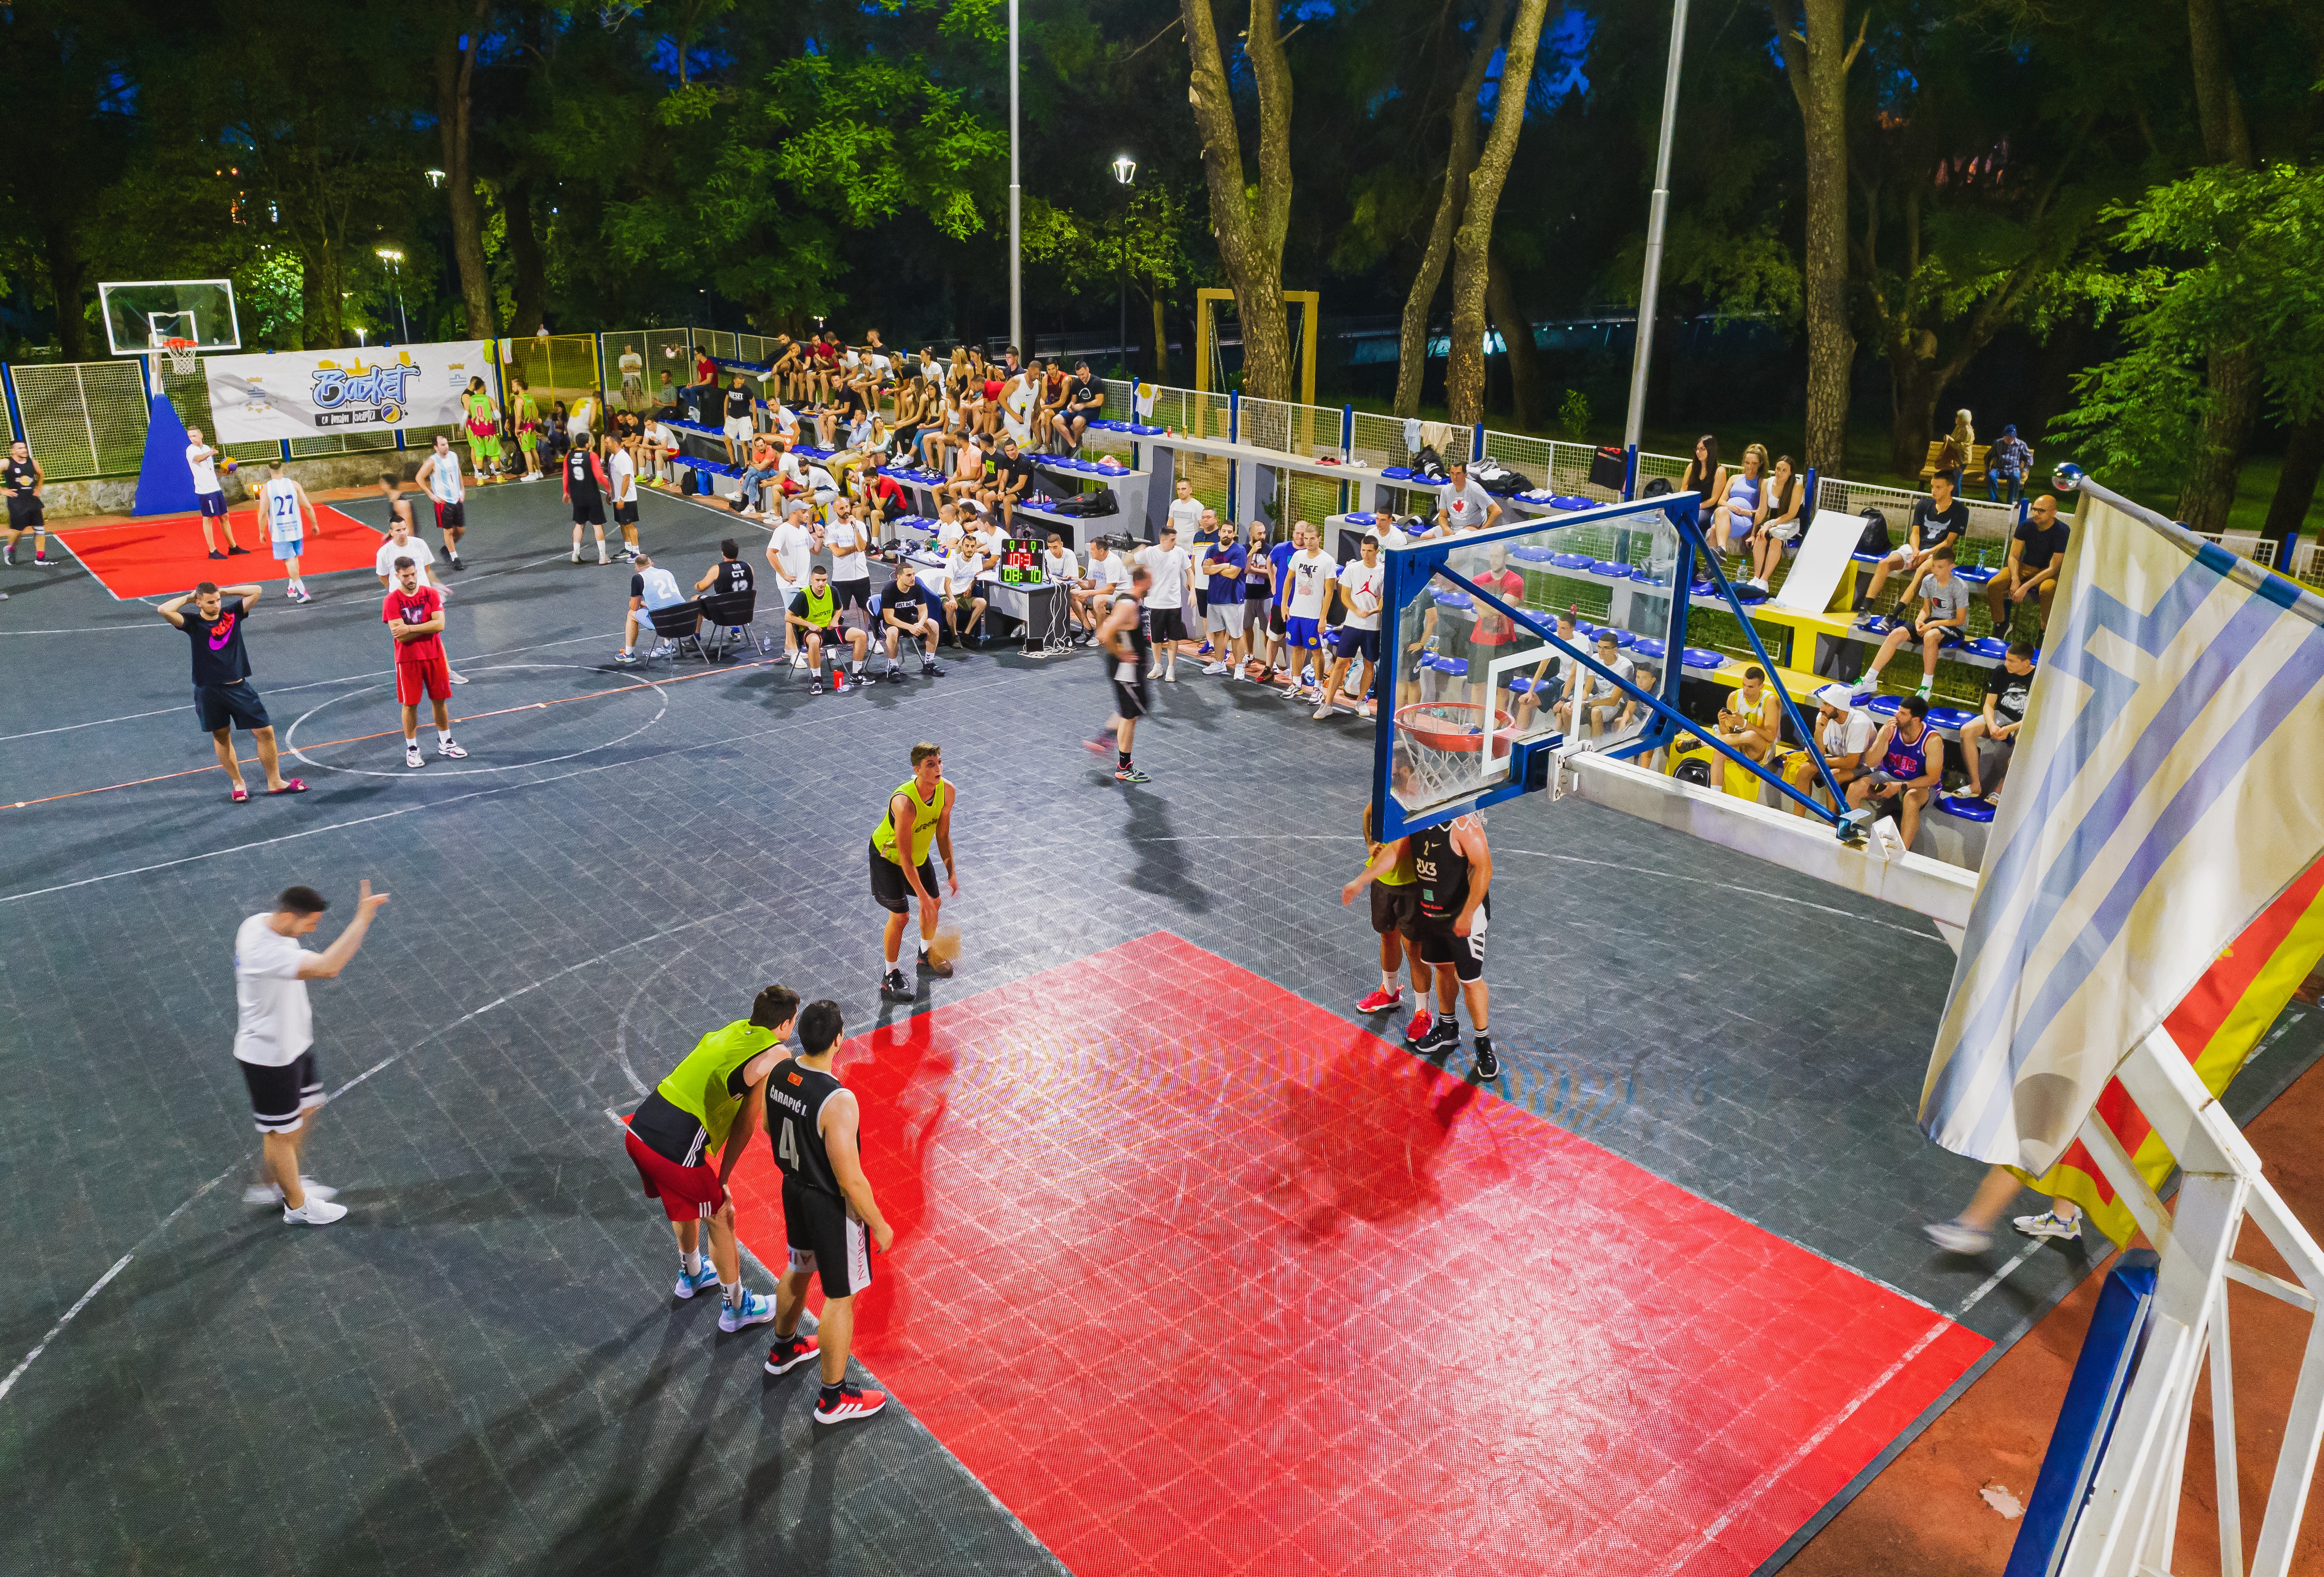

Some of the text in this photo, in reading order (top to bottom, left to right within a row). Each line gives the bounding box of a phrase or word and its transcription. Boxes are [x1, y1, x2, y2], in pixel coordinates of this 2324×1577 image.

[312, 363, 421, 409] Basket
[274, 494, 293, 516] 27
[779, 1117, 798, 1171] 4
